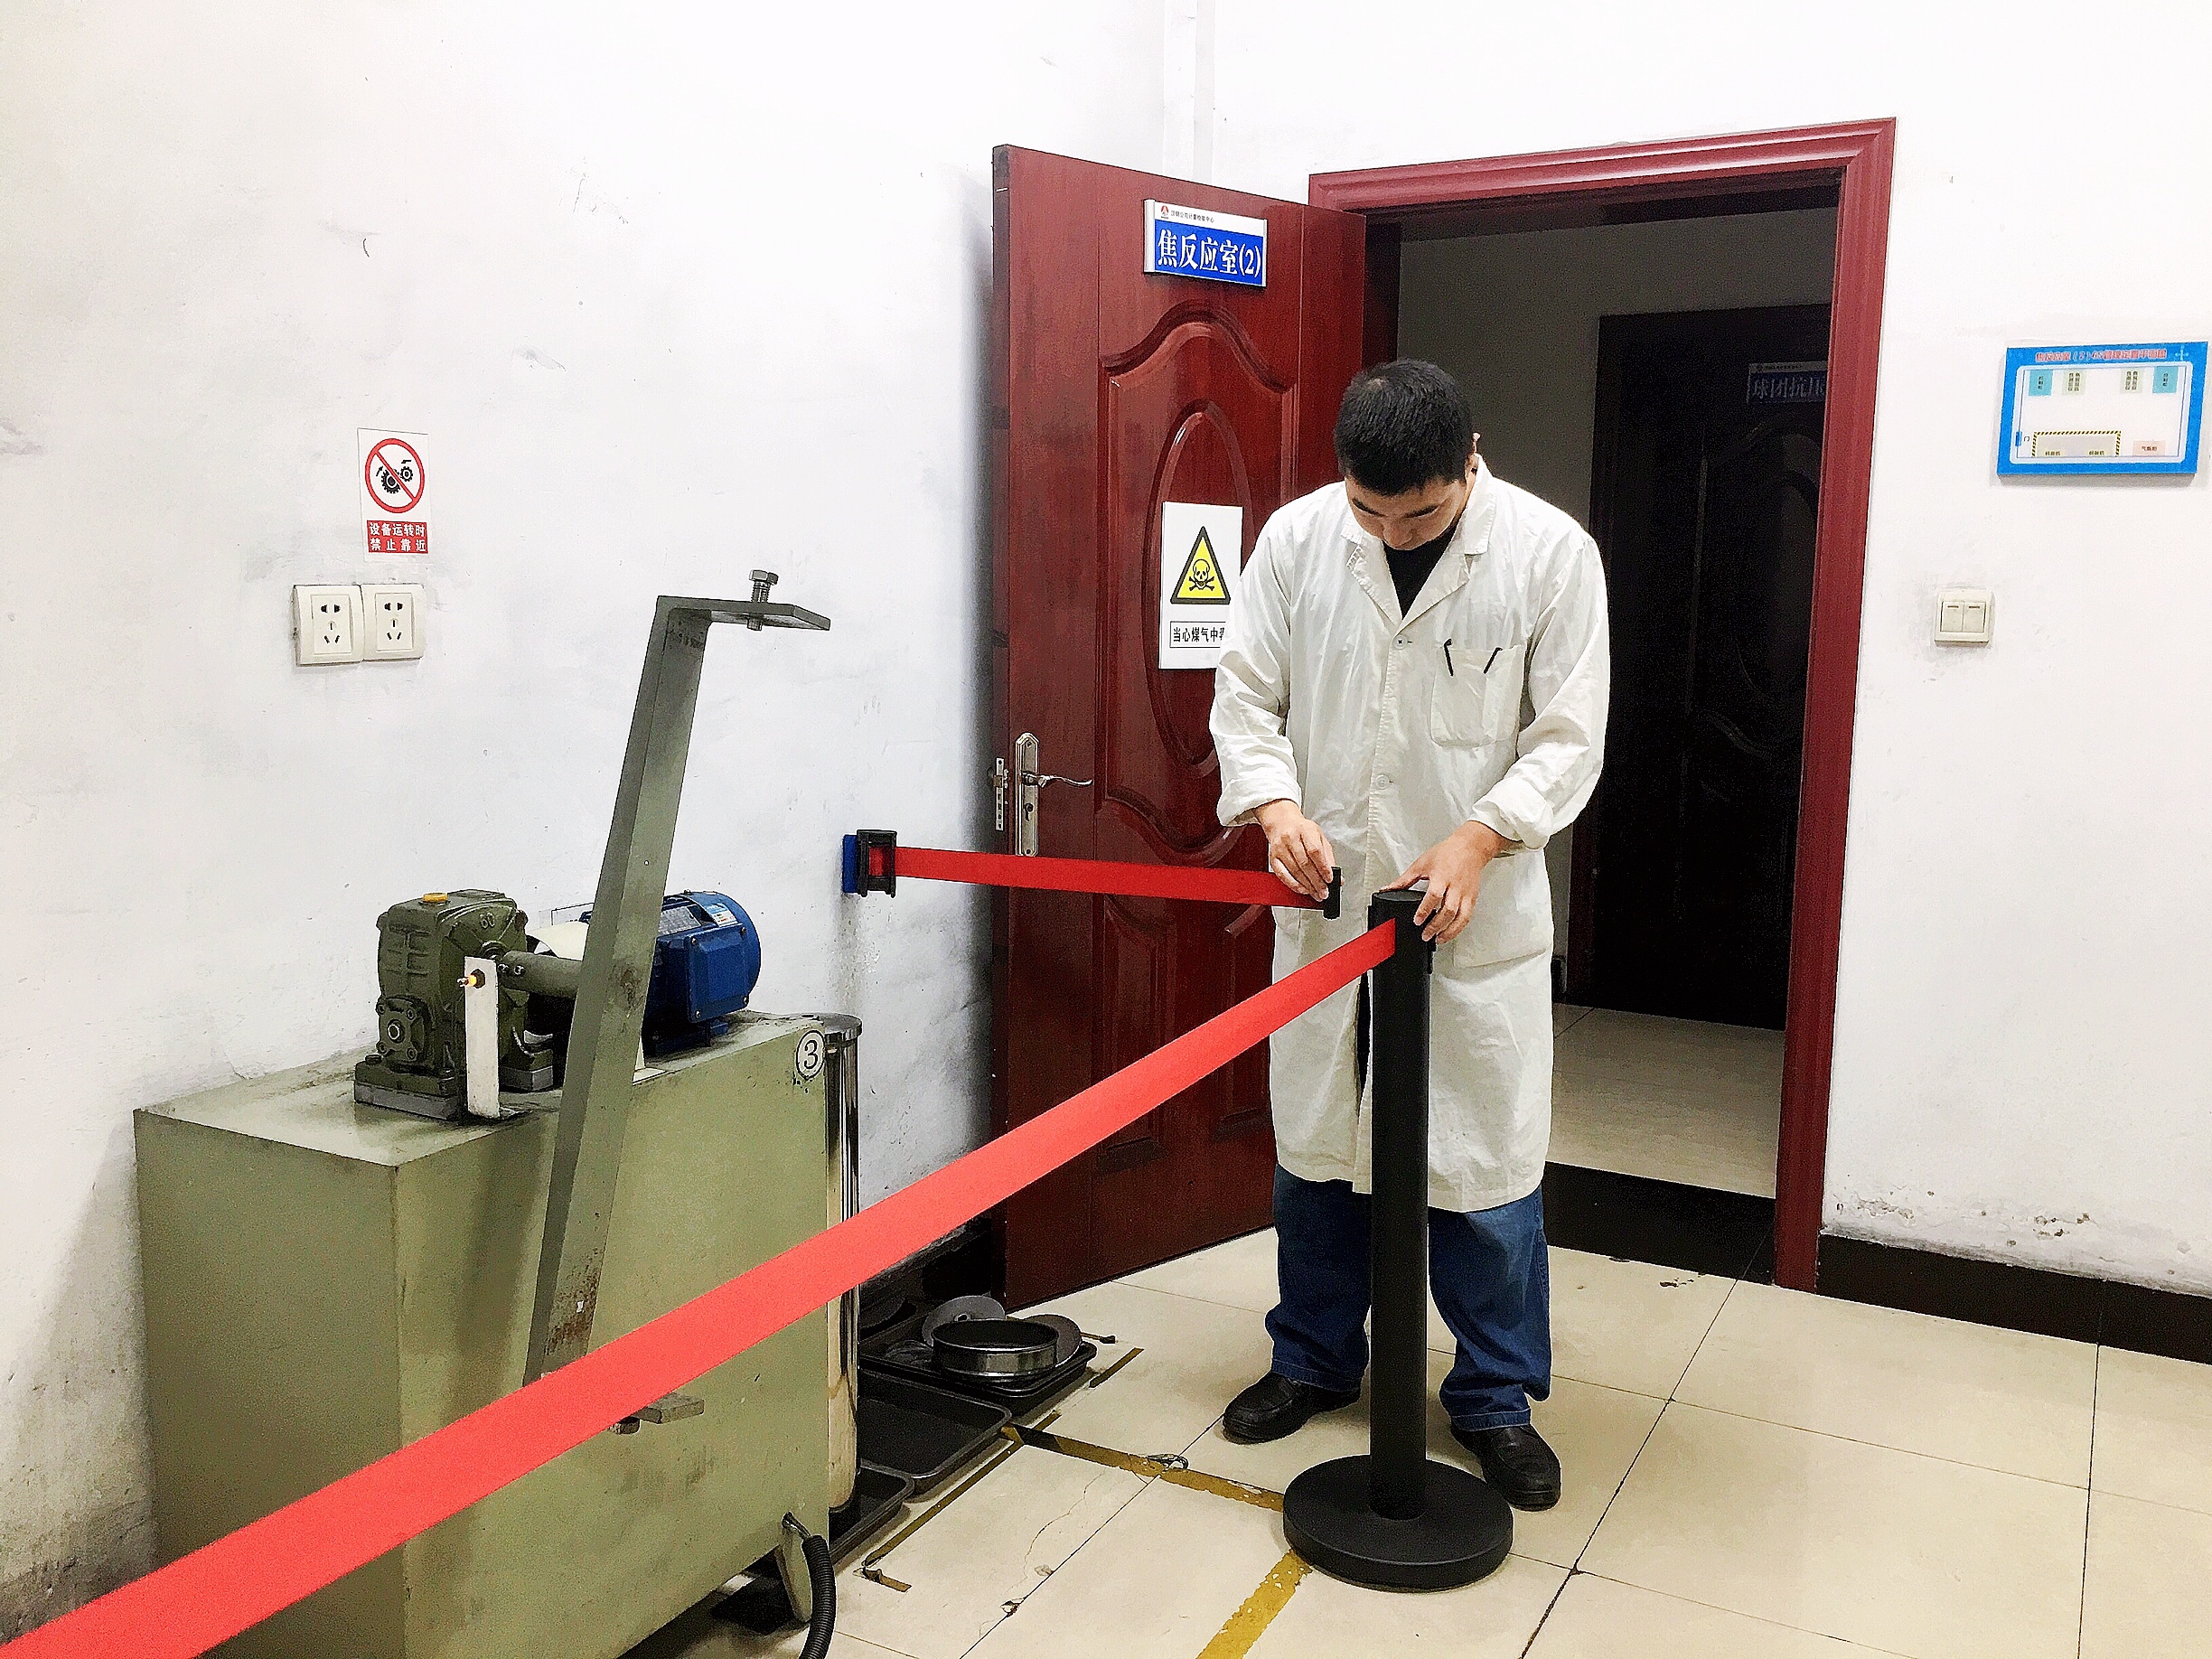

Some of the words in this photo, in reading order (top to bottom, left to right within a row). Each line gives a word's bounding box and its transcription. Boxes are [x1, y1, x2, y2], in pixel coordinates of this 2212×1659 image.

[369, 522, 426, 538] 设备运转时
[370, 538, 426, 552] 禁止靠近
